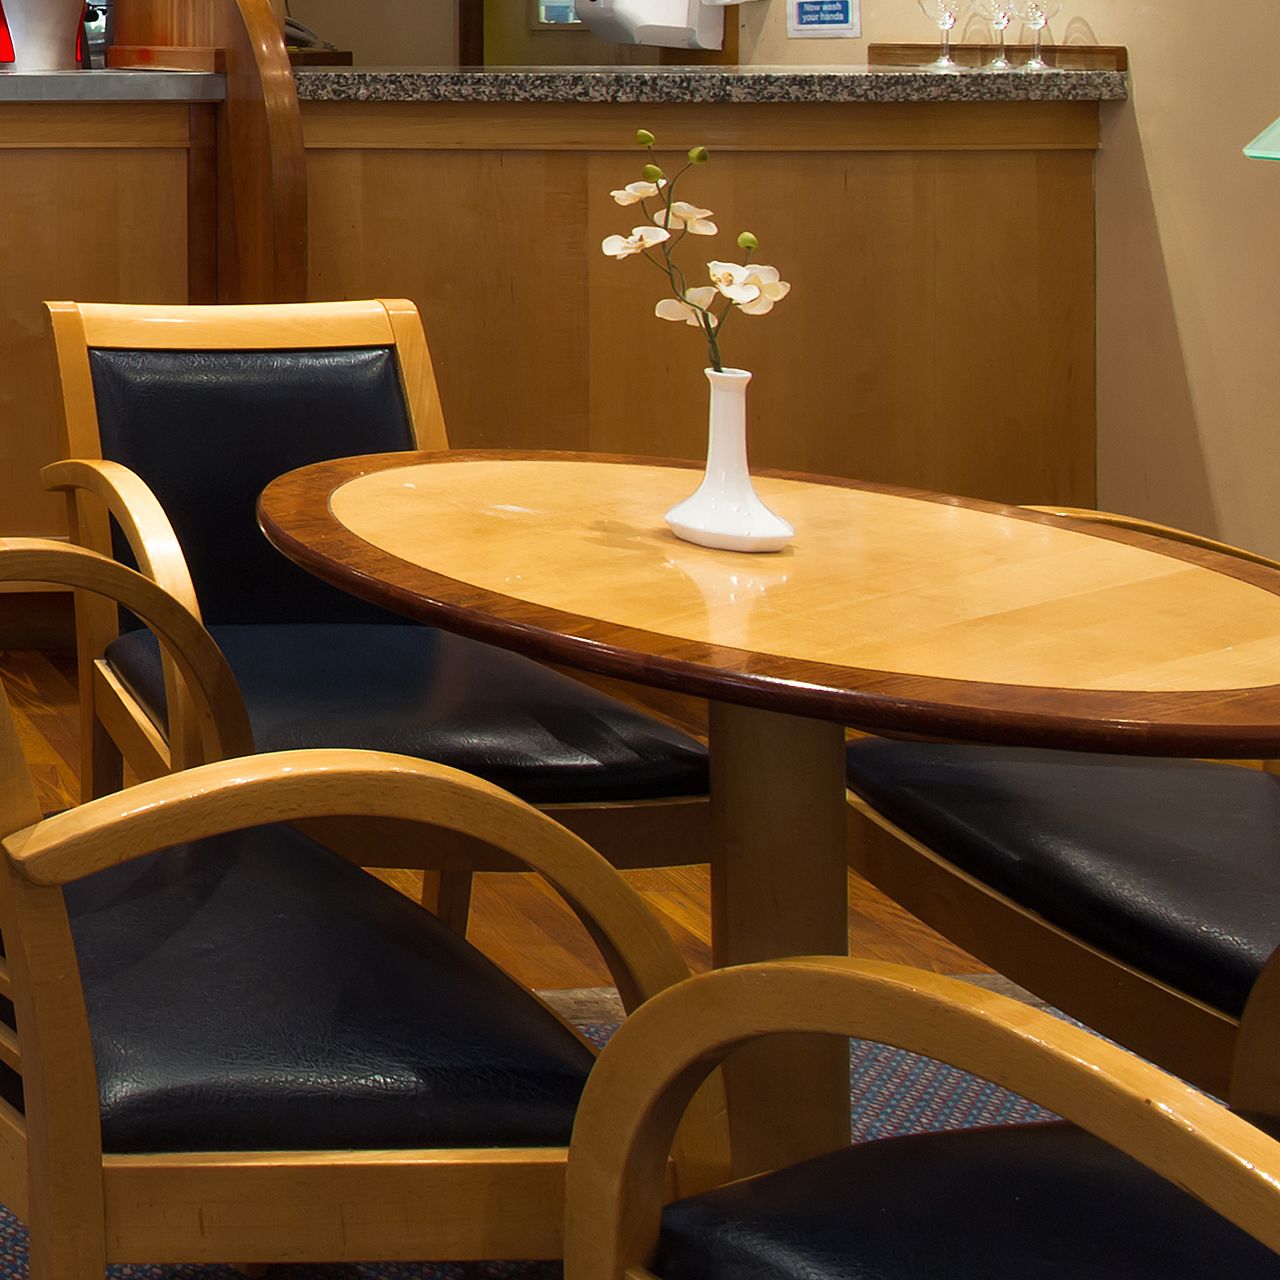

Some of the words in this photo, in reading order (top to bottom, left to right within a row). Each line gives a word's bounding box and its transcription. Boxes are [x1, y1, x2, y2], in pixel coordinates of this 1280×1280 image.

[804, 4, 820, 12] Now
[822, 2, 842, 11] wash
[802, 13, 819, 23] your
[820, 12, 844, 20] hands
